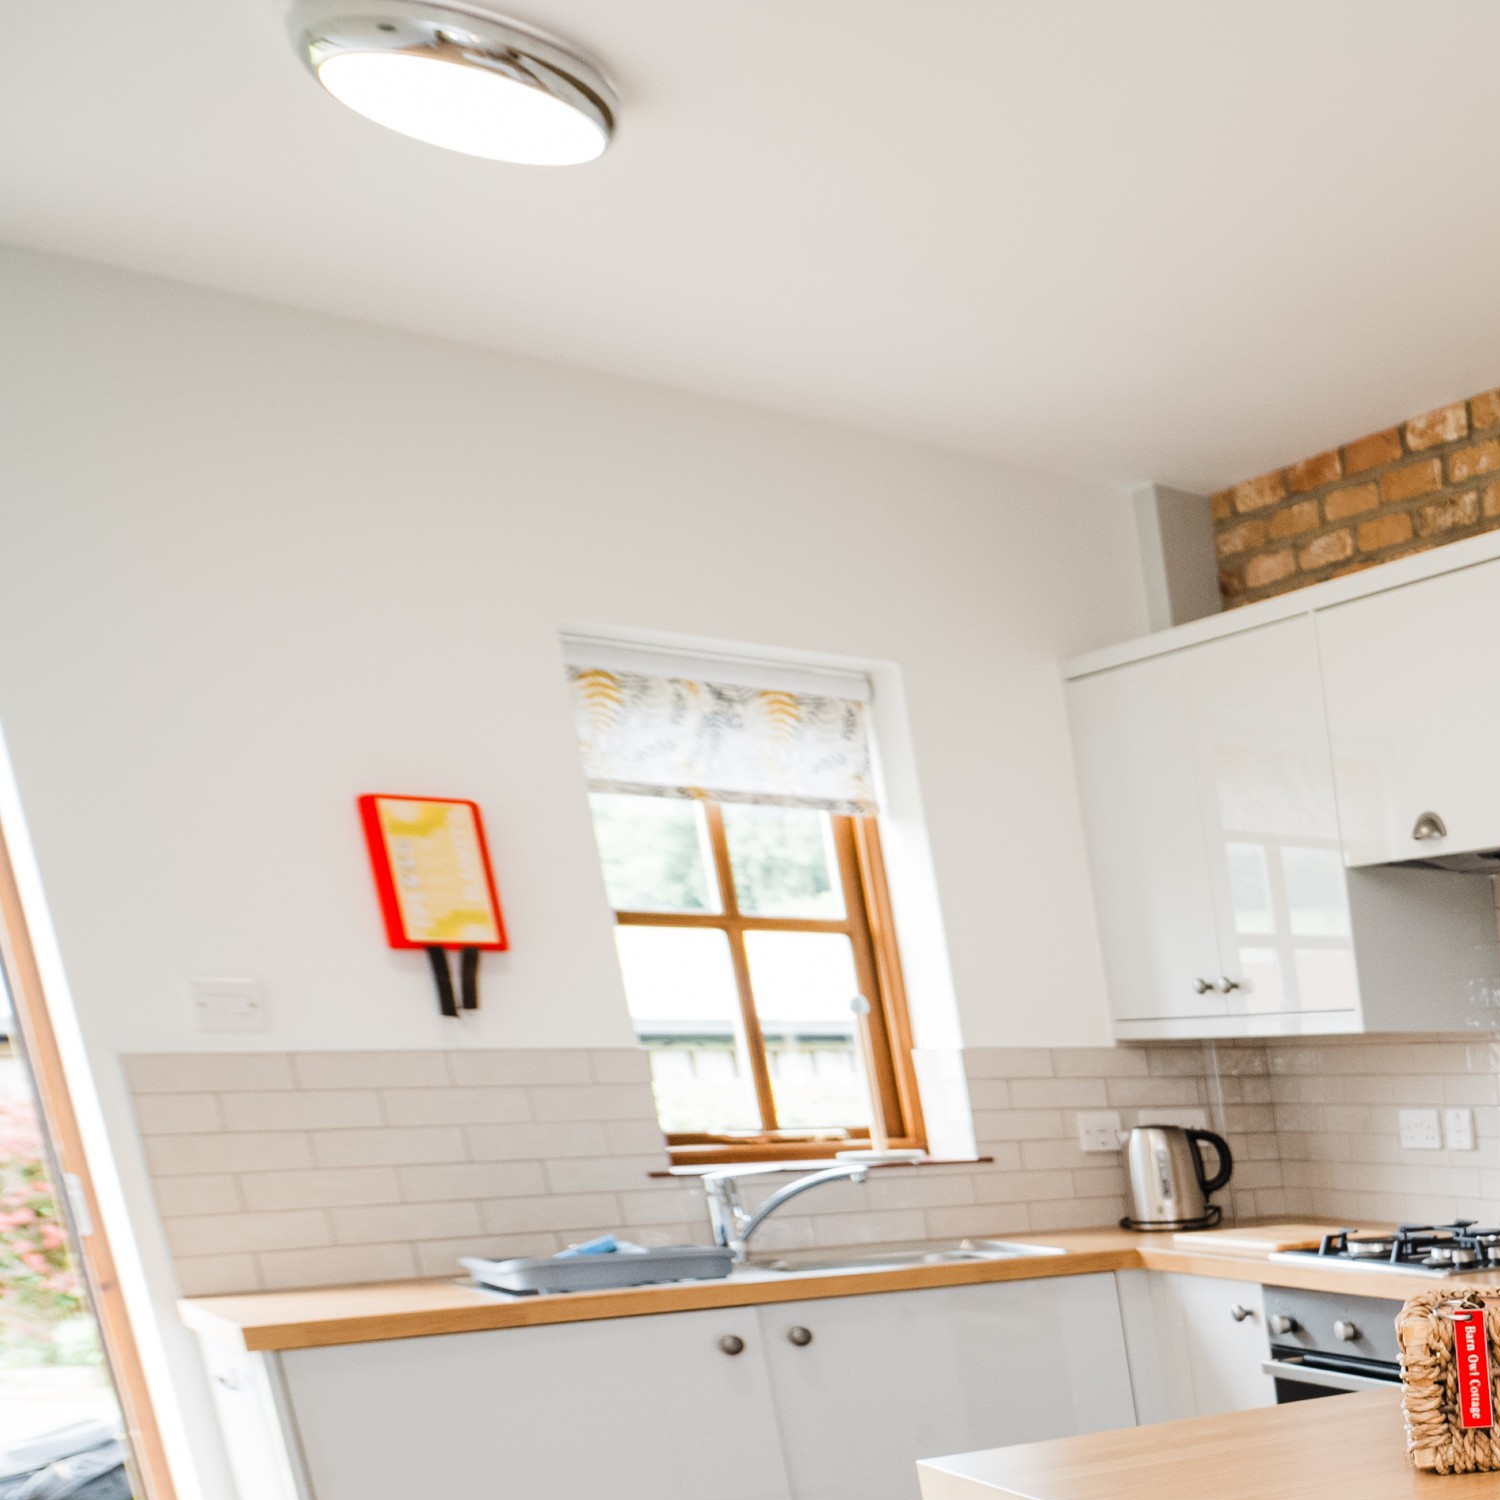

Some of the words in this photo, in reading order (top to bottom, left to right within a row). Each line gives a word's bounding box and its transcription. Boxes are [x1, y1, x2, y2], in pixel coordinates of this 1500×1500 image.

[1464, 1325, 1477, 1352] Barn
[1467, 1354, 1480, 1376] Owl
[1469, 1378, 1482, 1419] Cottage
